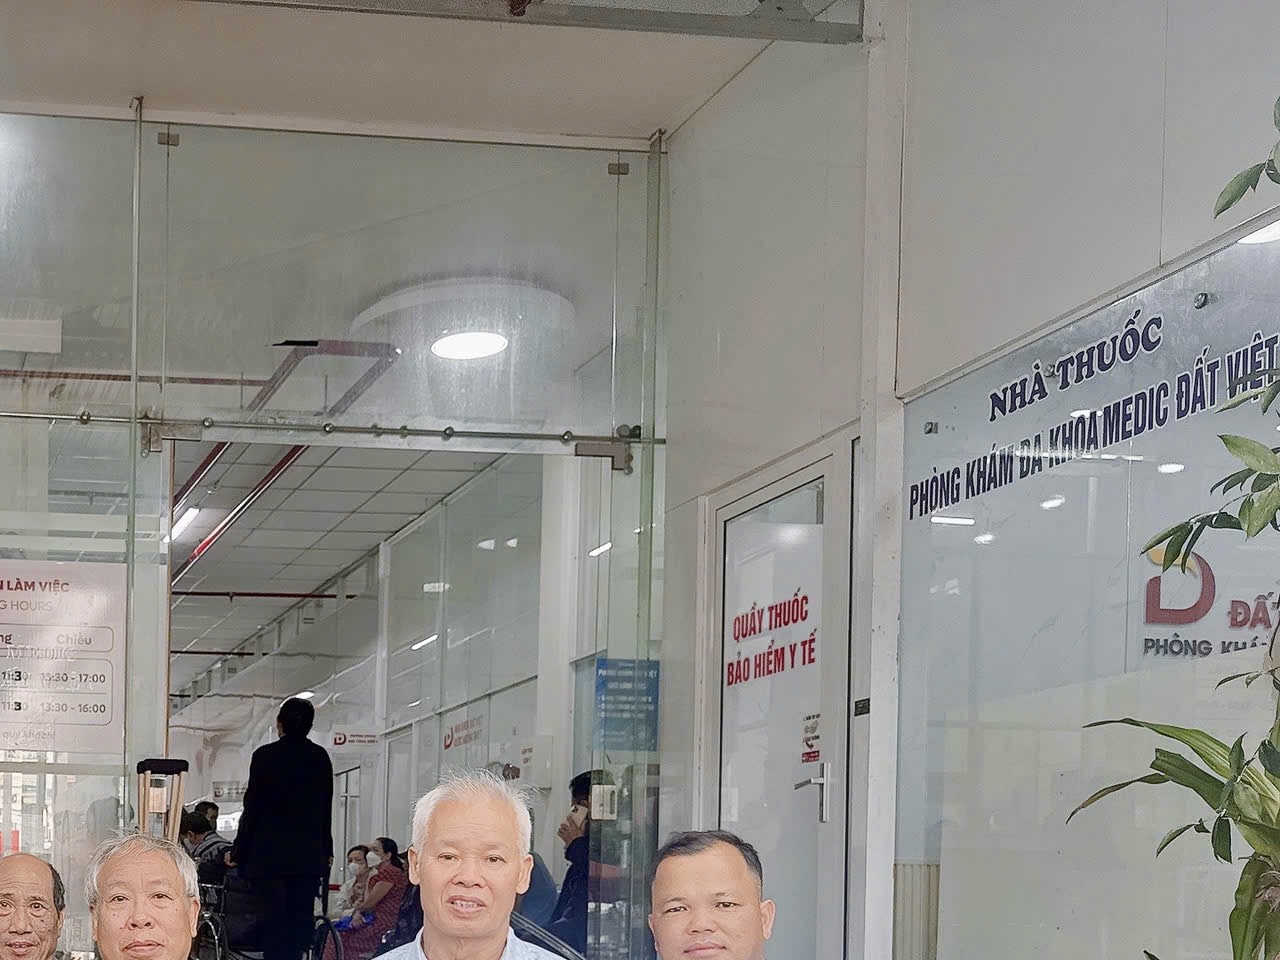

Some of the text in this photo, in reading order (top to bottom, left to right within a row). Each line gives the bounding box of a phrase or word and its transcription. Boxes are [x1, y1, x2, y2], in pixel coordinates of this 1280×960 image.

[989, 309, 1163, 421] NHÀ THUỐC
[909, 332, 1279, 520] PHÒNG KHÁM ĐA KHOA MEDIC ĐẤT VIỆT
[7, 578, 36, 592] LÀM
[36, 579, 70, 595] VIỆC
[10, 600, 53, 612] HOURS
[733, 587, 809, 643] QUẦY THUỐC
[1227, 592, 1280, 629] ĐẤ
[727, 628, 818, 686] BẢO HIỂM Y TẾ
[1143, 633, 1213, 658] PHÒNG
[79, 673, 106, 683] 17:00
[2, 701, 29, 711] 11:30
[78, 703, 106, 713] 16:00
